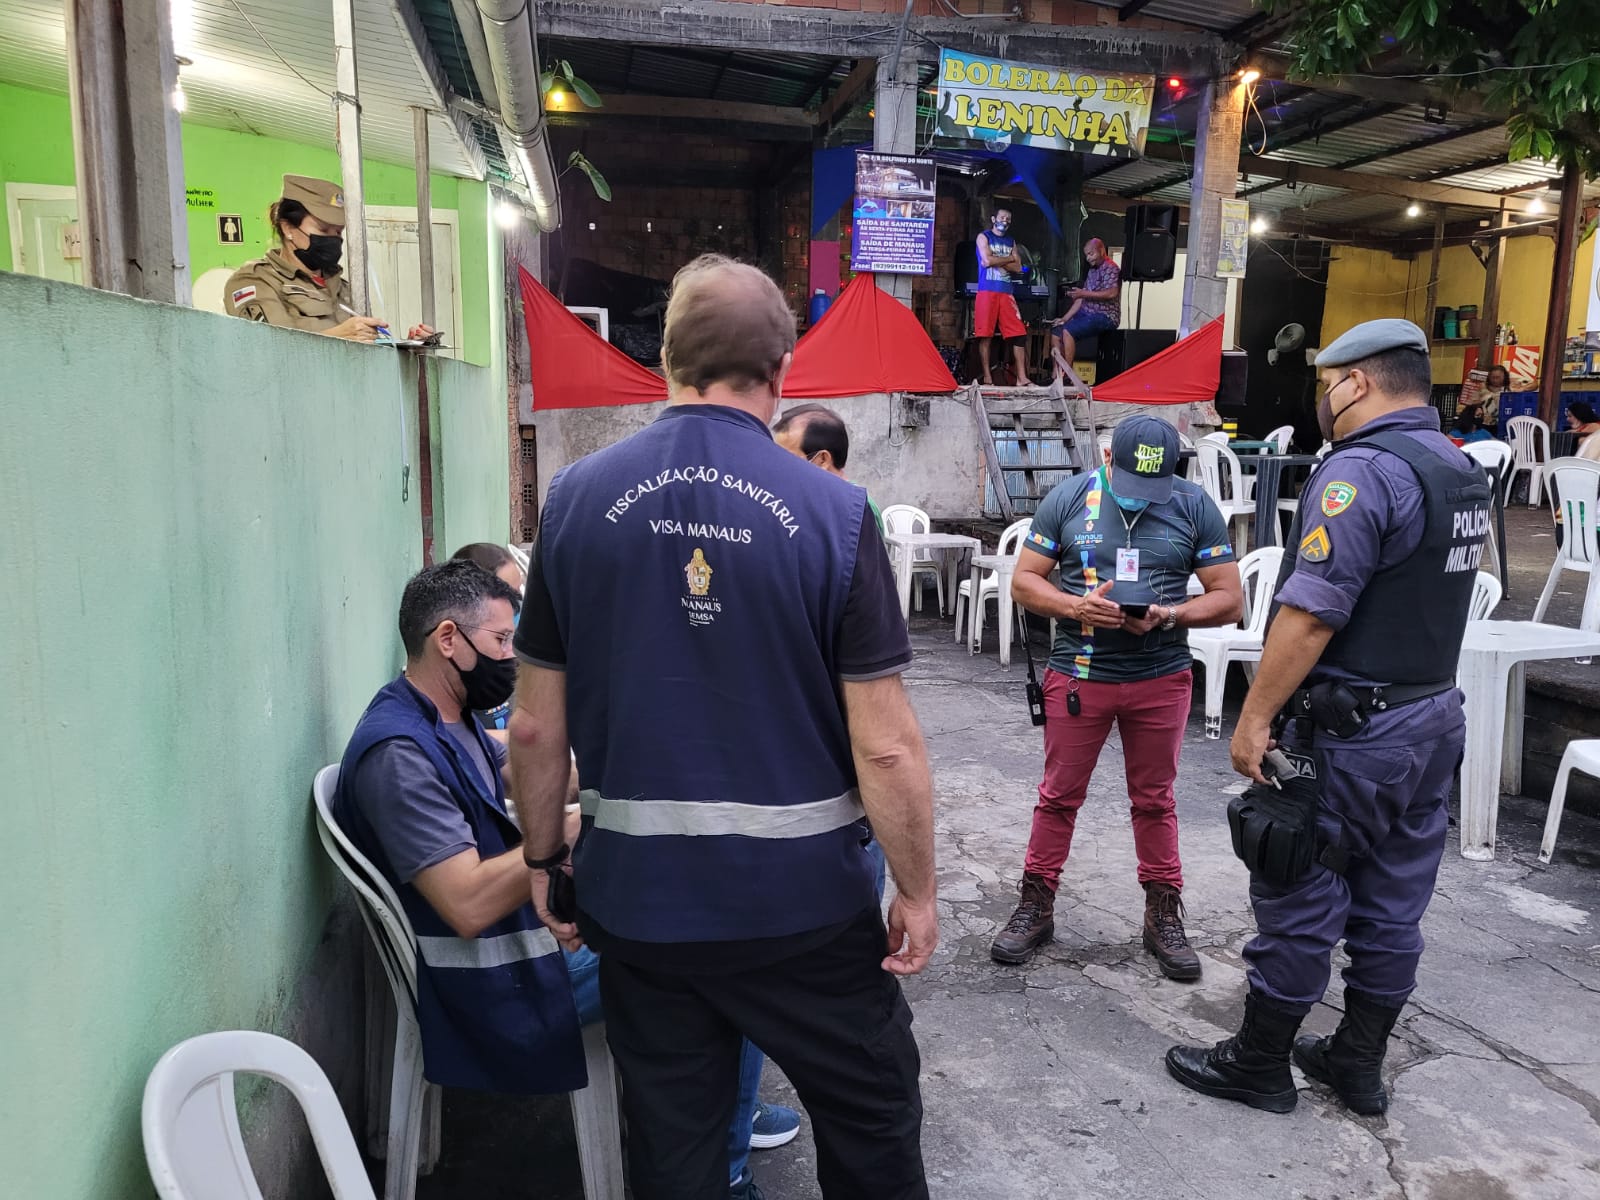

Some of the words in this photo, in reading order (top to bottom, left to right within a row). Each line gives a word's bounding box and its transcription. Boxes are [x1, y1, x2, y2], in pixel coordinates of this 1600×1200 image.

[944, 58, 1097, 98] BOLERÃO
[1103, 78, 1148, 105] DA
[953, 95, 1129, 145] LENINHA
[890, 221, 929, 229] SANTARÉM
[894, 241, 925, 249] MANAUS
[605, 466, 718, 524] FISCALIZAÇÃO
[721, 474, 800, 538] SANITÁRIA
[649, 519, 684, 536] VISA
[687, 522, 752, 544] MANAUS
